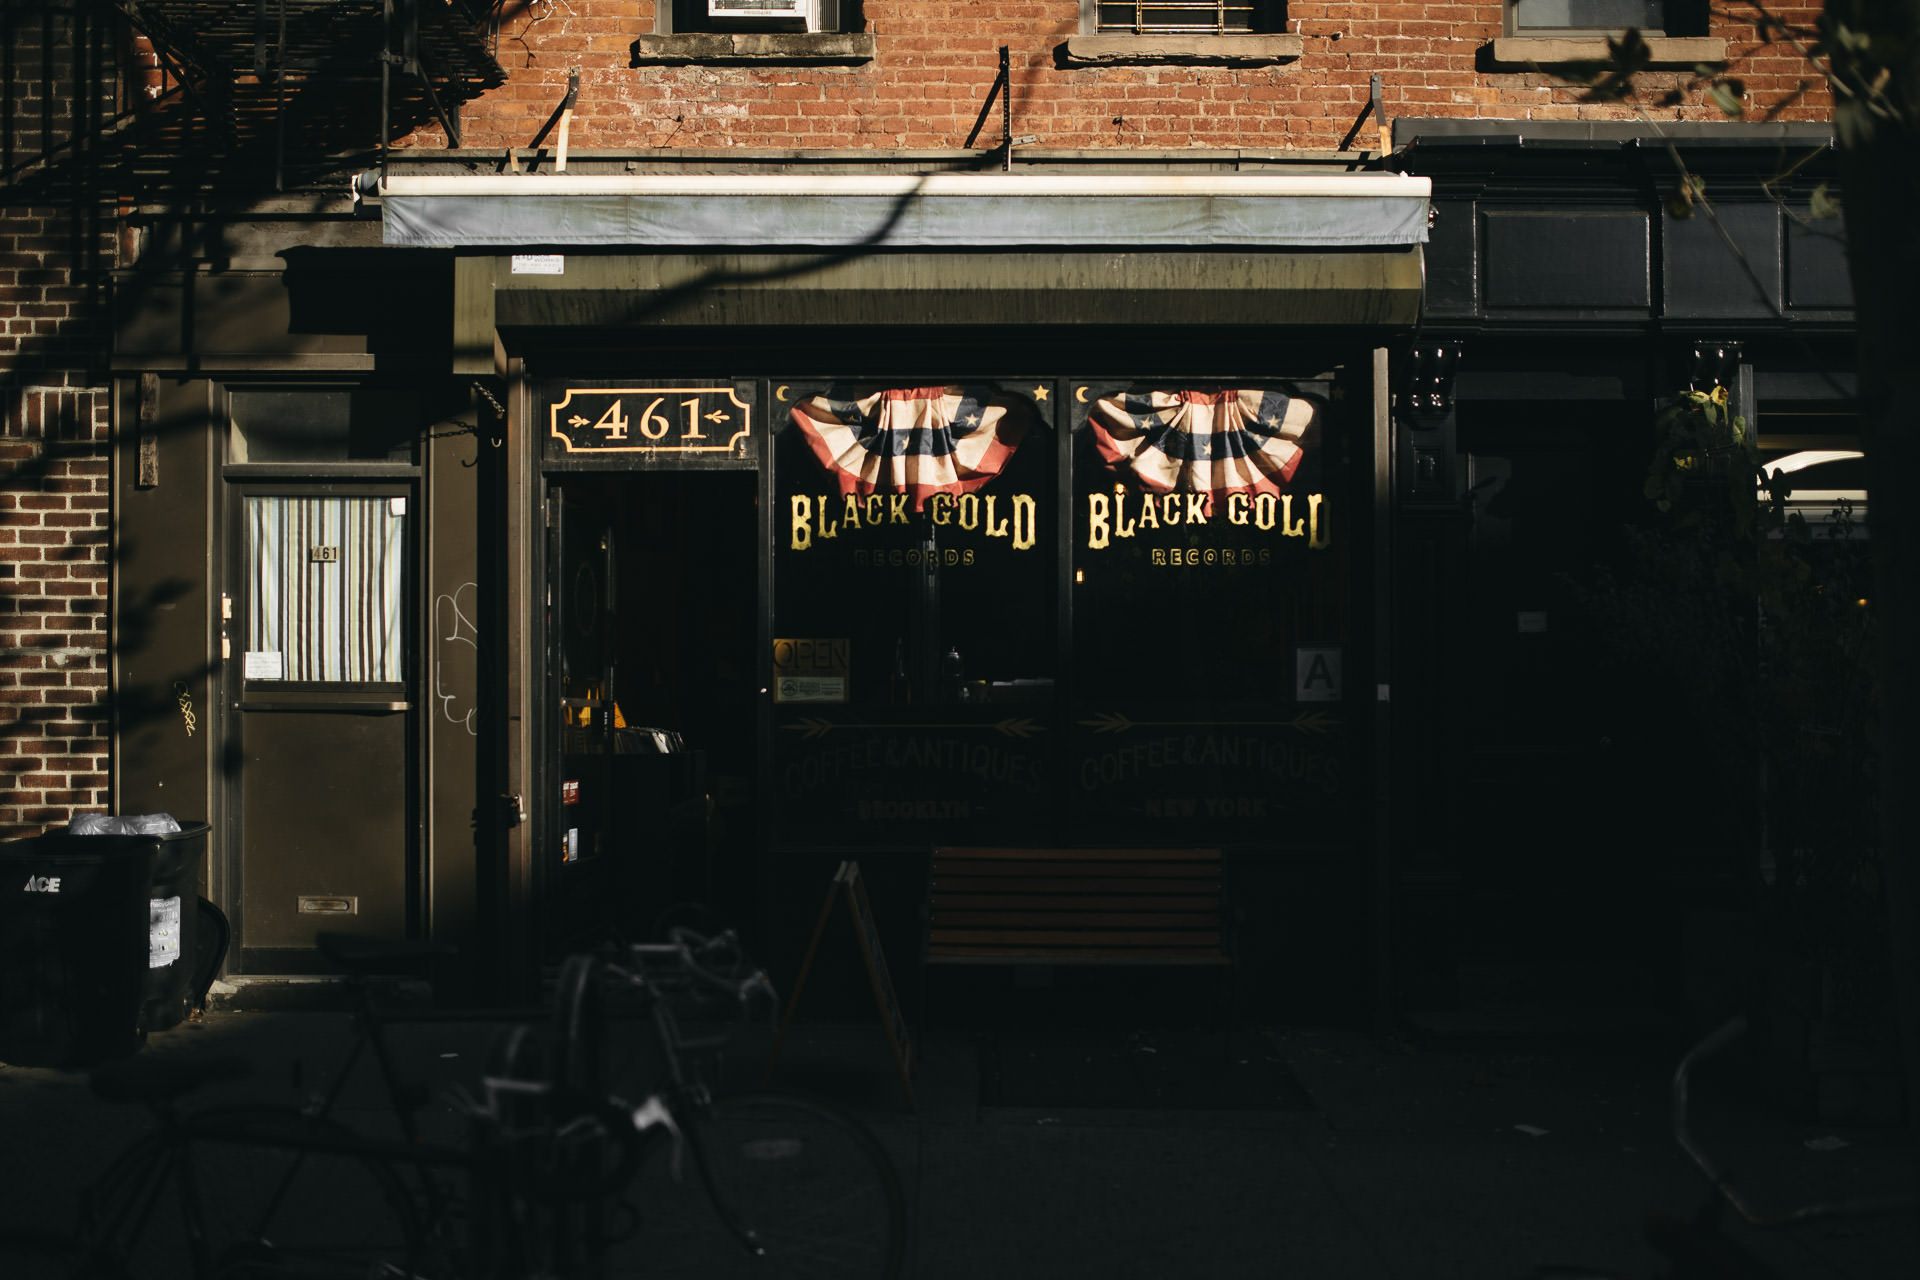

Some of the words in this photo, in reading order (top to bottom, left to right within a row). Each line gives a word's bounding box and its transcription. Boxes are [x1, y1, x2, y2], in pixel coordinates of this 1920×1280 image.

[593, 397, 707, 440] 461
[790, 492, 910, 551] BLACK
[931, 492, 1037, 551] GOLD
[1088, 492, 1208, 550] BLACK
[1227, 492, 1331, 550] GOLD
[313, 547, 337, 560] 461
[854, 548, 975, 567] RECORDS
[1151, 548, 1272, 567] RECORDS
[771, 639, 848, 670] OPEN
[1303, 653, 1335, 689] A
[856, 800, 969, 820] BROOKLYN
[1144, 798, 1198, 818] NEW
[1204, 798, 1267, 818] YORK
[23, 874, 61, 893] ACE
